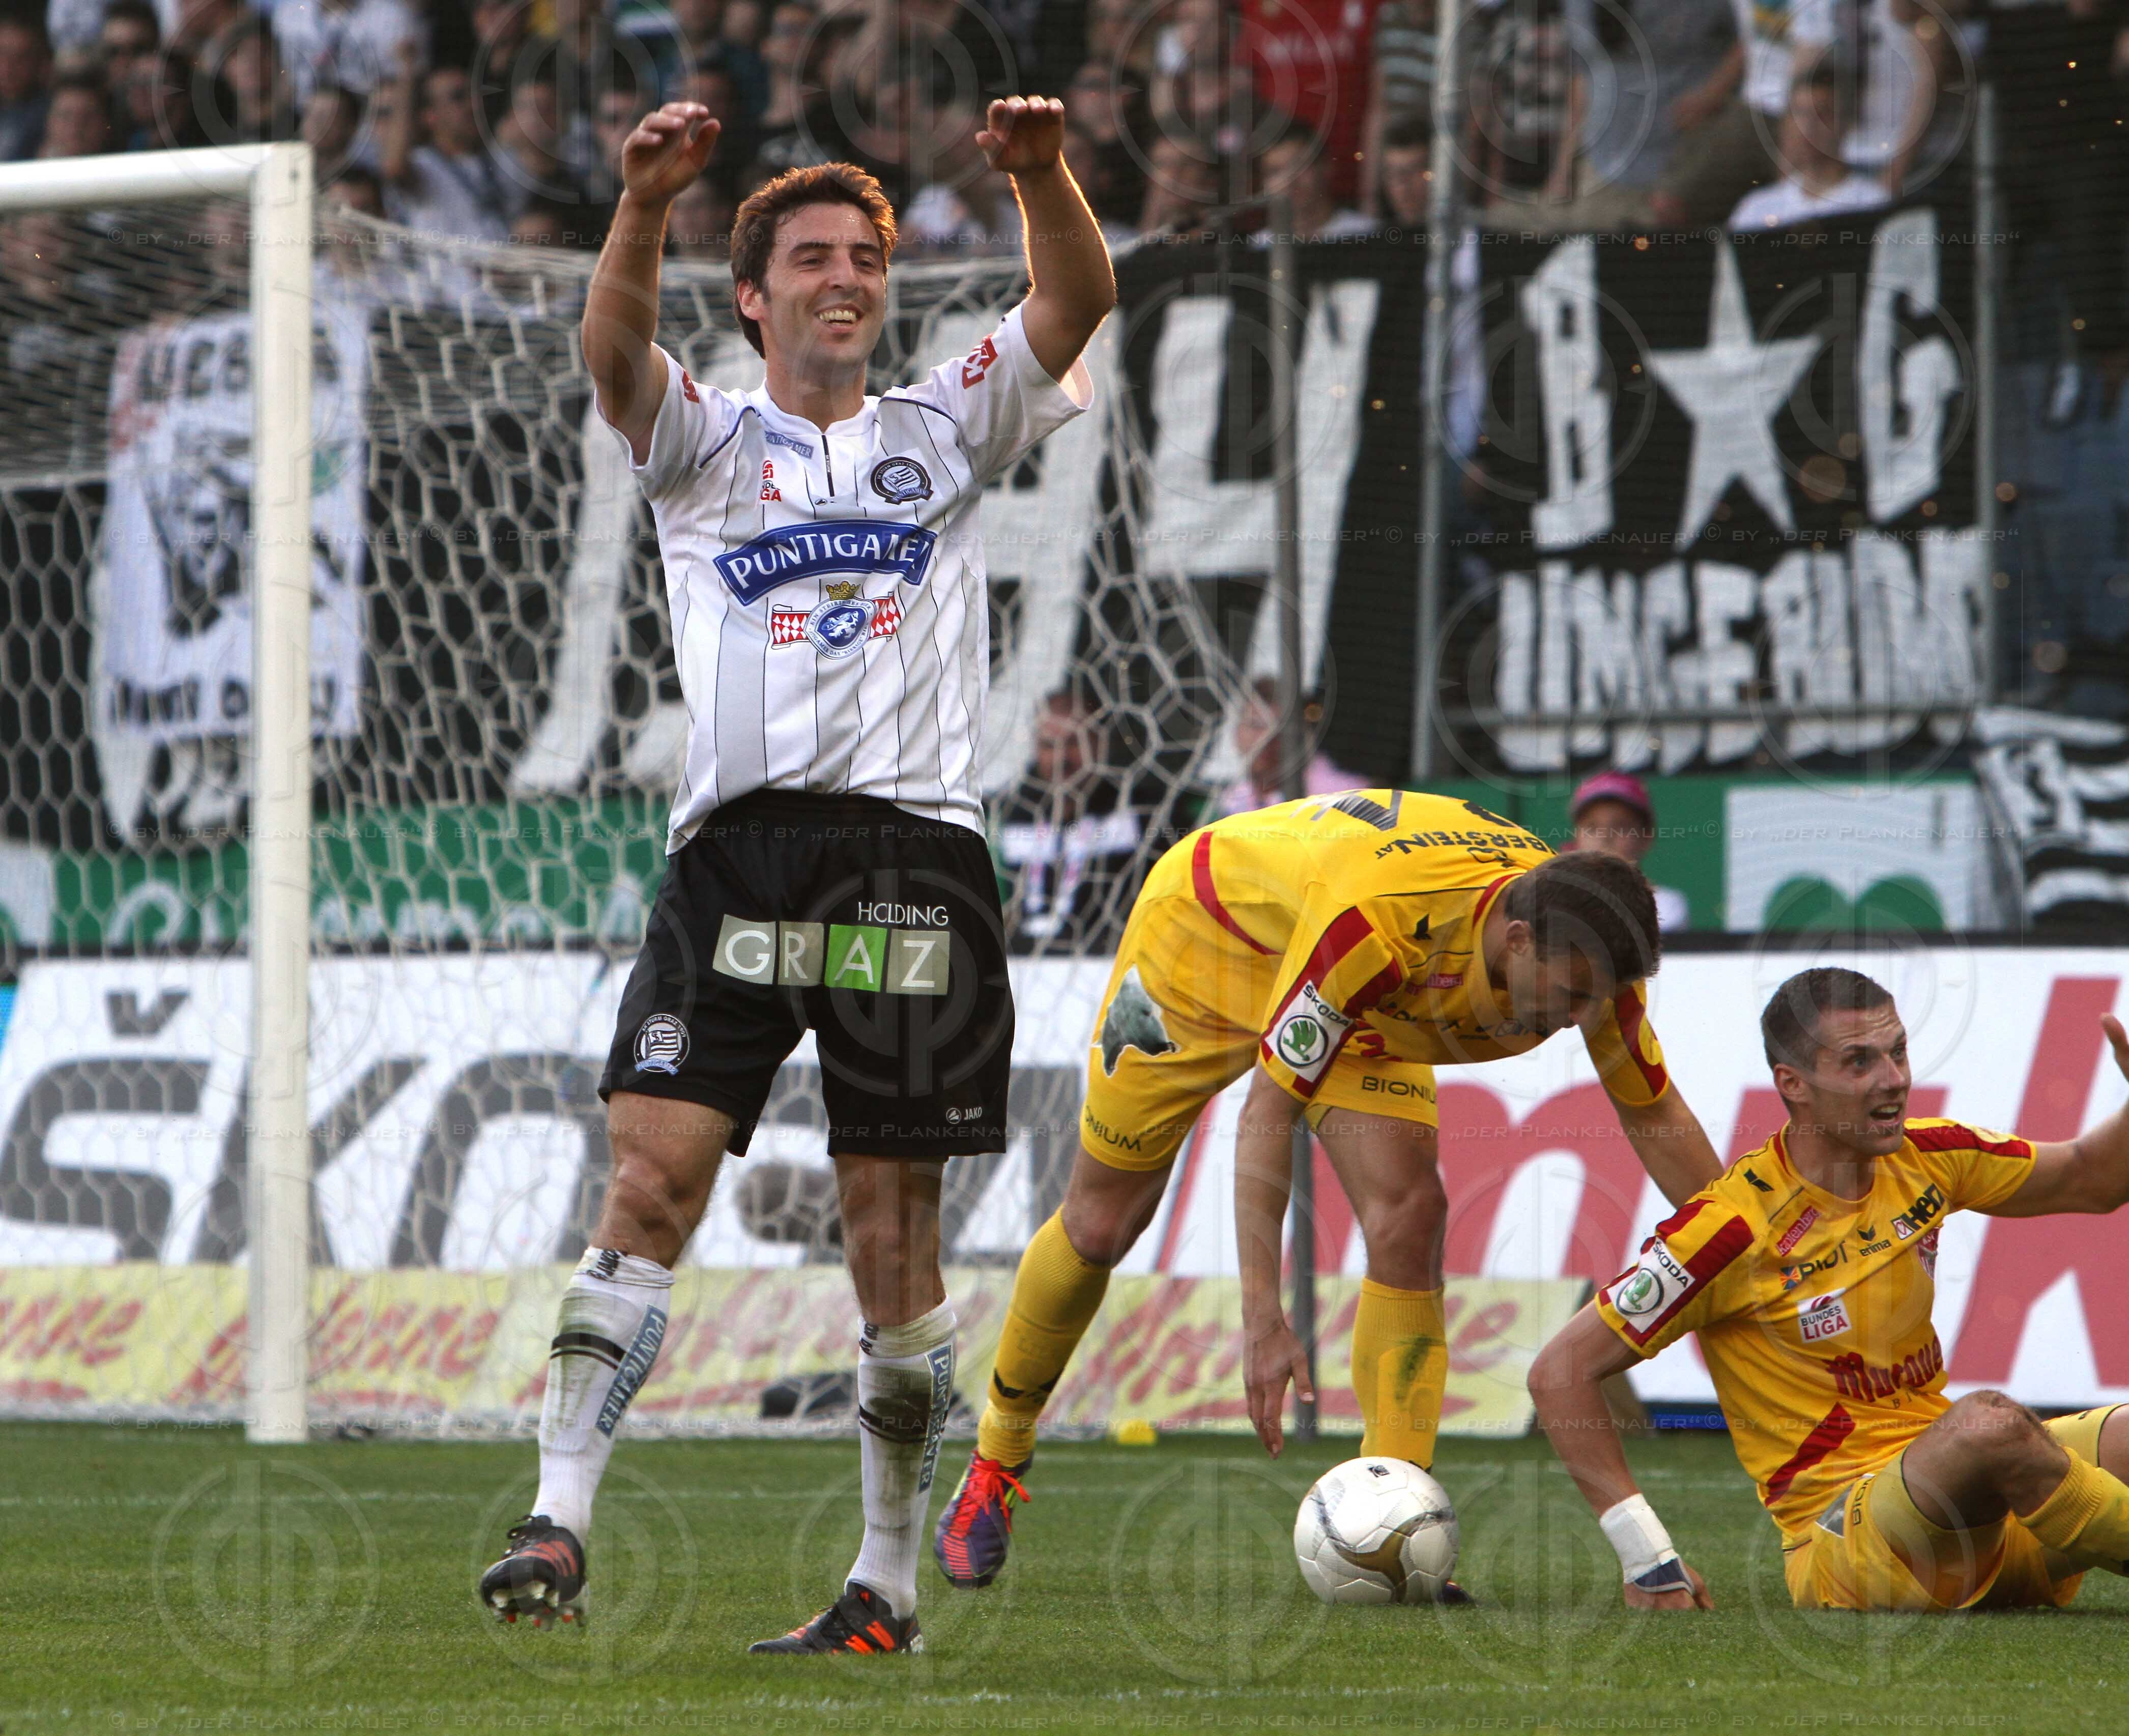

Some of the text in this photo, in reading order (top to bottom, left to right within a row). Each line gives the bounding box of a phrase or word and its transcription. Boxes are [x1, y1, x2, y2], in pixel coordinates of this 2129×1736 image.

[724, 928, 937, 988] GRAZ
[964, 1106, 983, 1121] JAKO
[1859, 1238, 1892, 1257] erima
[1652, 1239, 1688, 1288] ŠKODA
[1801, 1305, 1842, 1326] BUNDES
[1803, 1315, 1849, 1341] LIGA
